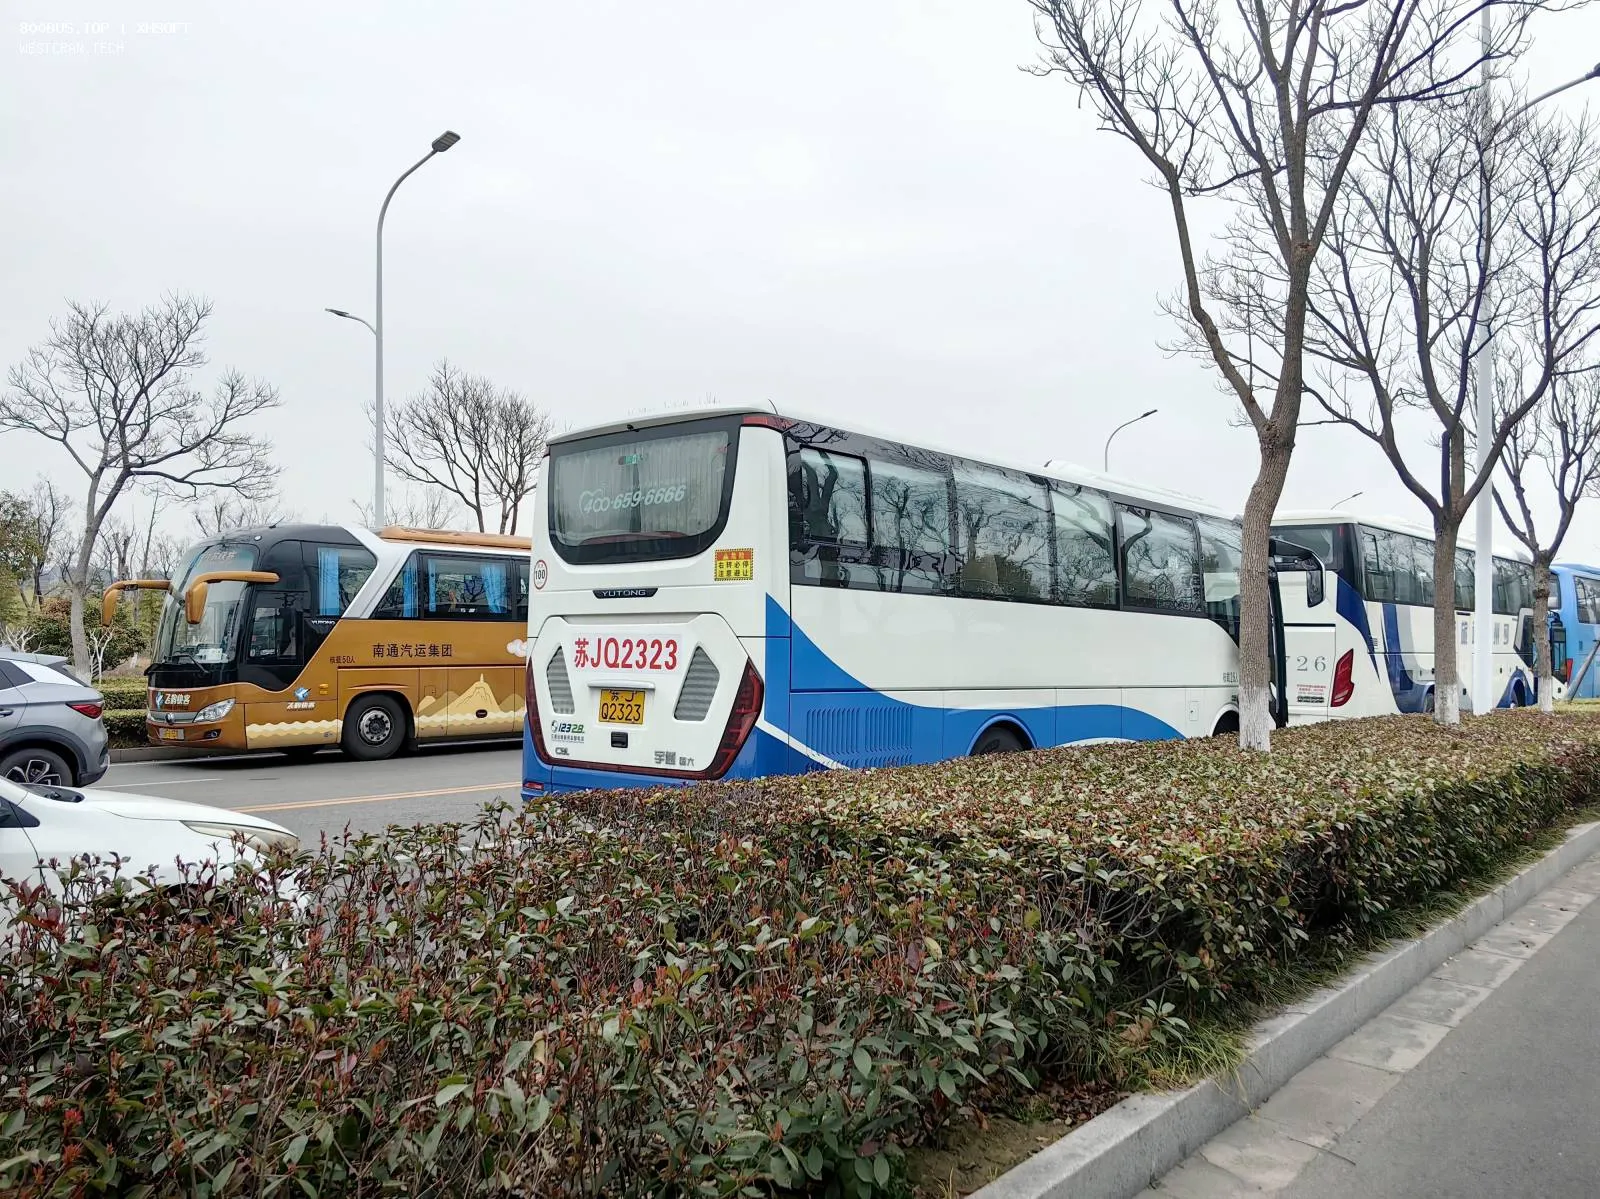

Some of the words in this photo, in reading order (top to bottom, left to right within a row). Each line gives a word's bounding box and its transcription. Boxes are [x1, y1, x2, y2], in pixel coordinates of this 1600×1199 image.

[535, 569, 546, 580] 100
[372, 643, 453, 658] 南通汽运集团
[574, 637, 678, 670] 苏JQ2323
[601, 703, 641, 722] Q2323
